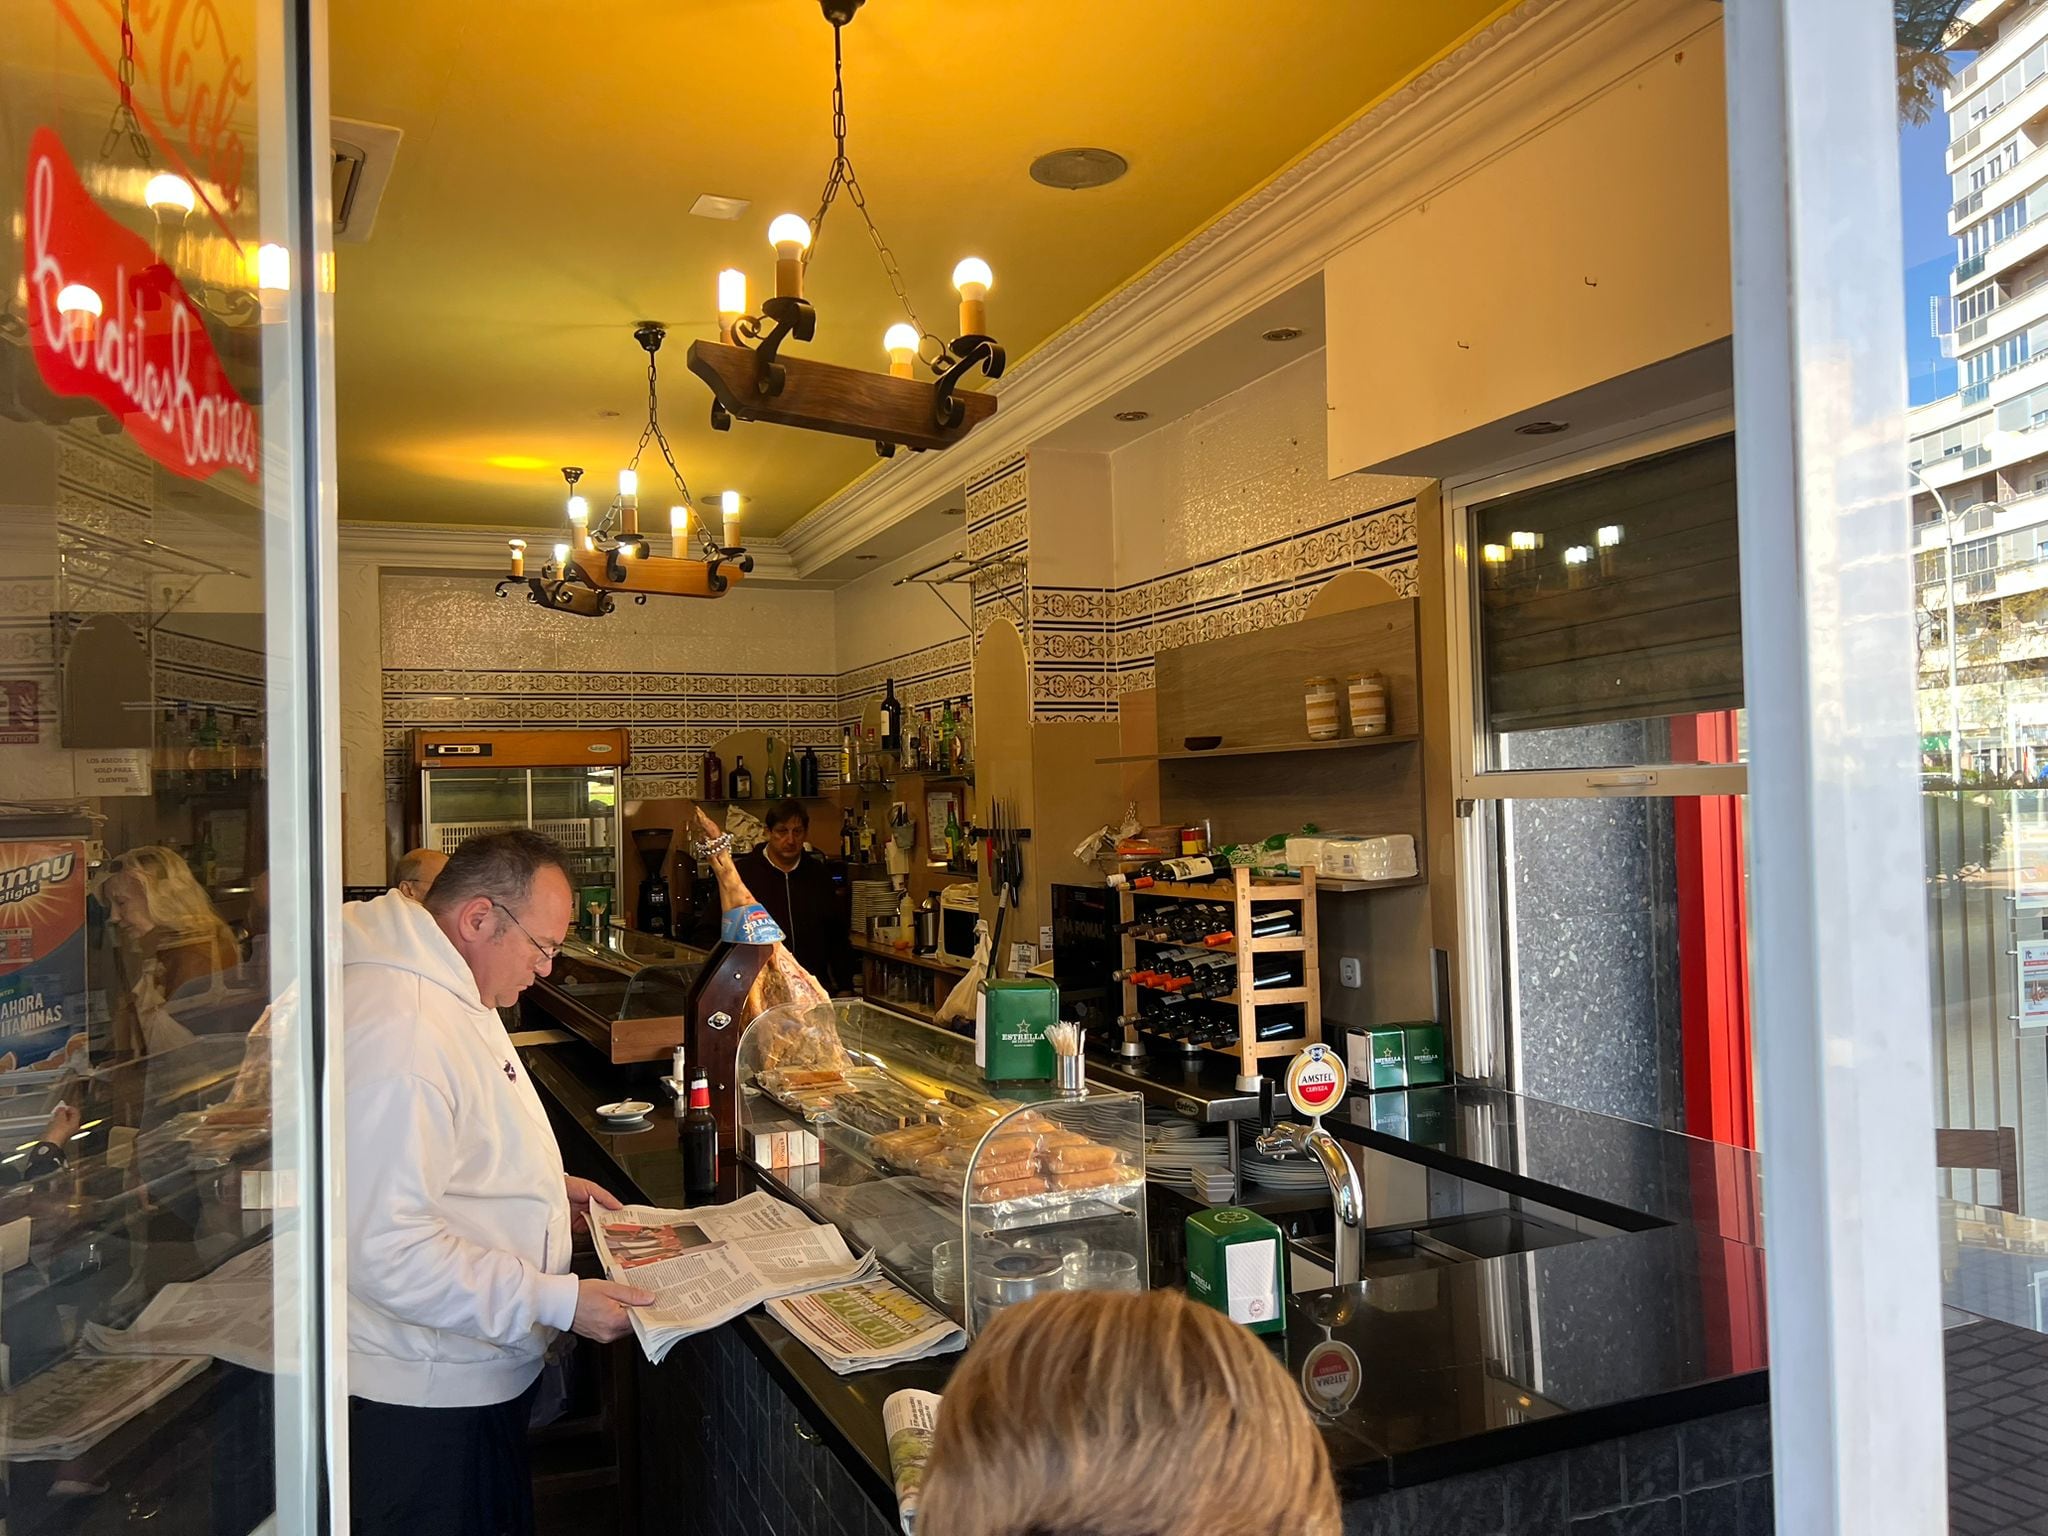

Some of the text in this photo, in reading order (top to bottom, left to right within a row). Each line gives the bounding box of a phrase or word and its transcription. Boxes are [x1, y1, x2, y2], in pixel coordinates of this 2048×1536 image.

[0, 993, 44, 1020] AHORA
[1002, 1033, 1045, 1041] ESTRELLA
[1375, 1056, 1401, 1064] ESTRELLA
[1302, 1073, 1333, 1084] AMSTEL
[1306, 1085, 1329, 1093] CERVEZA
